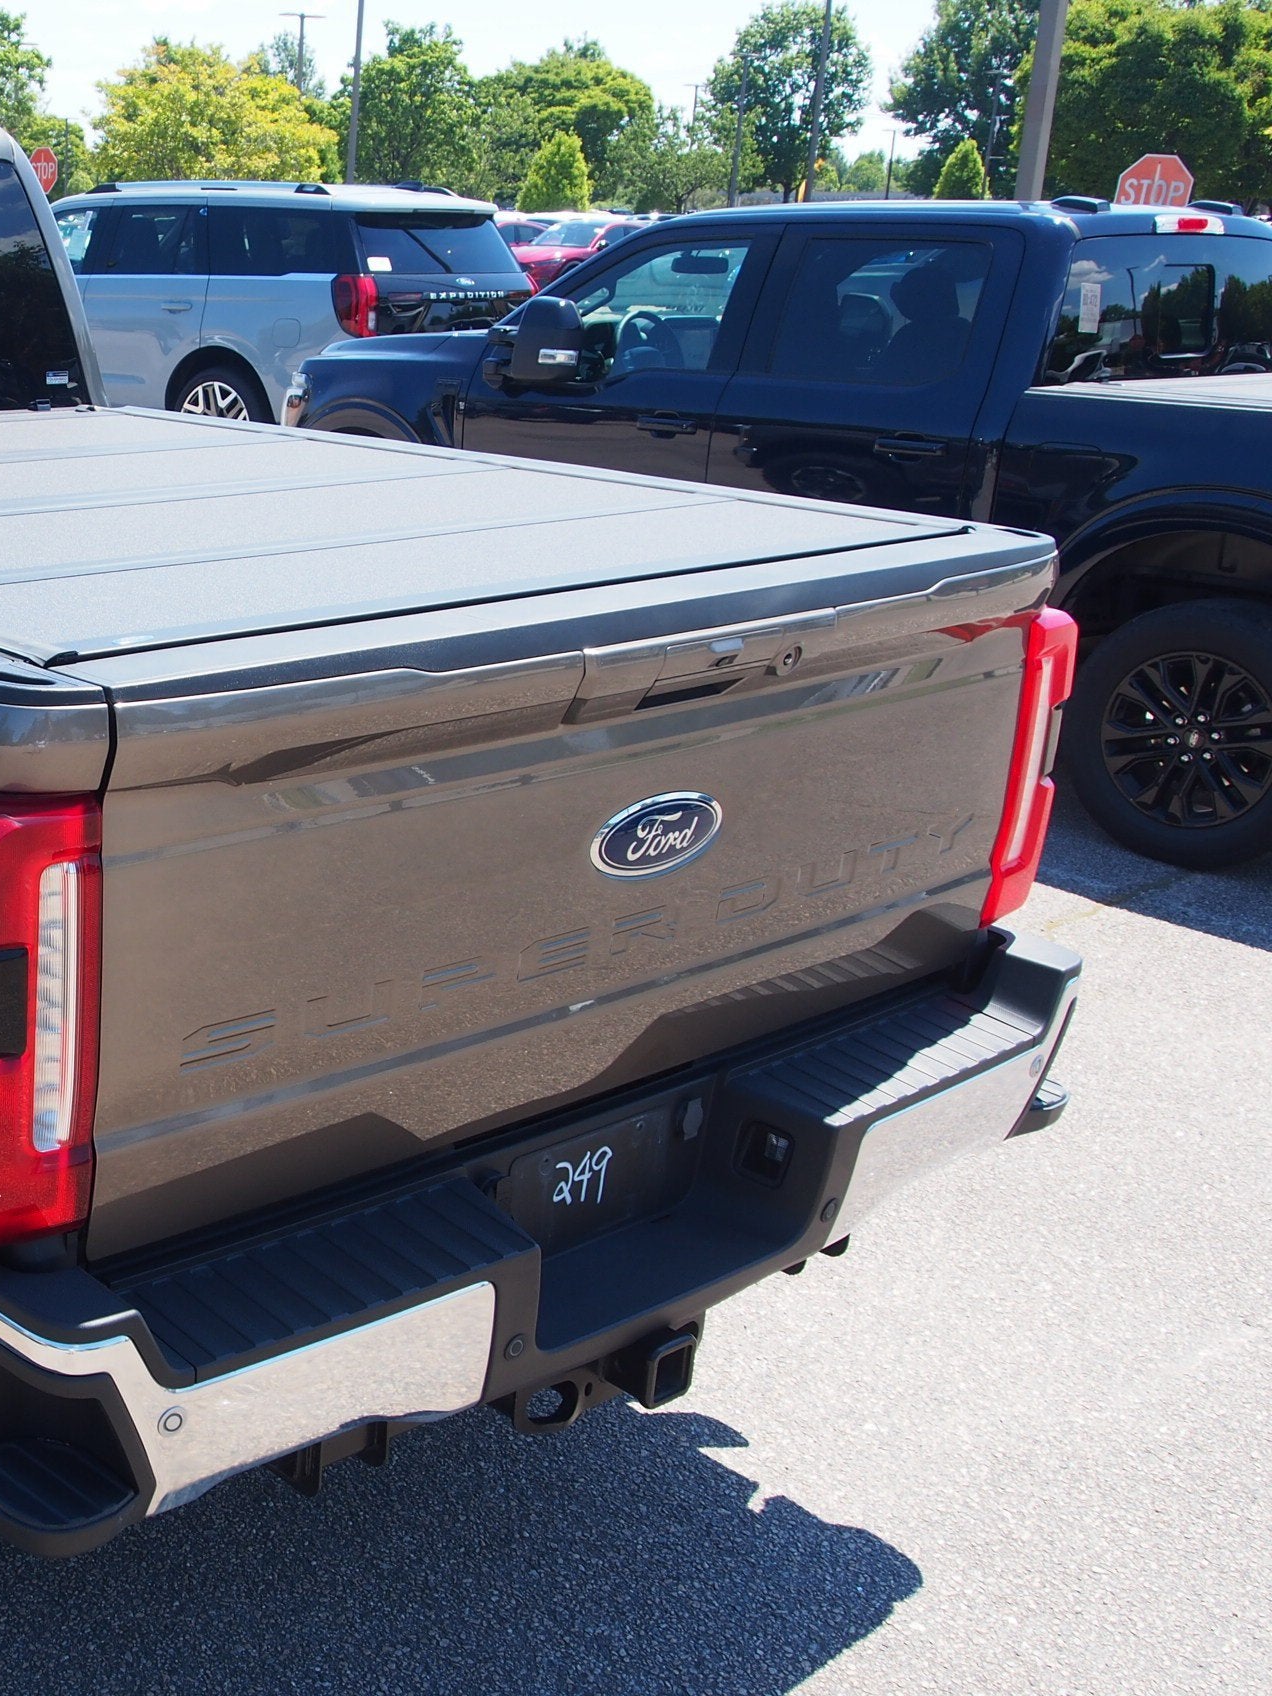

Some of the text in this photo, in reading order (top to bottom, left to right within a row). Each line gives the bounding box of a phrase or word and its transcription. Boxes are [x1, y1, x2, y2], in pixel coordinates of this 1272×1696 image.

[1121, 178, 1185, 206] STOP
[429, 290, 505, 300] EXPEDITION
[179, 812, 974, 1075] SUPER DUTY
[552, 1145, 613, 1206] 249
